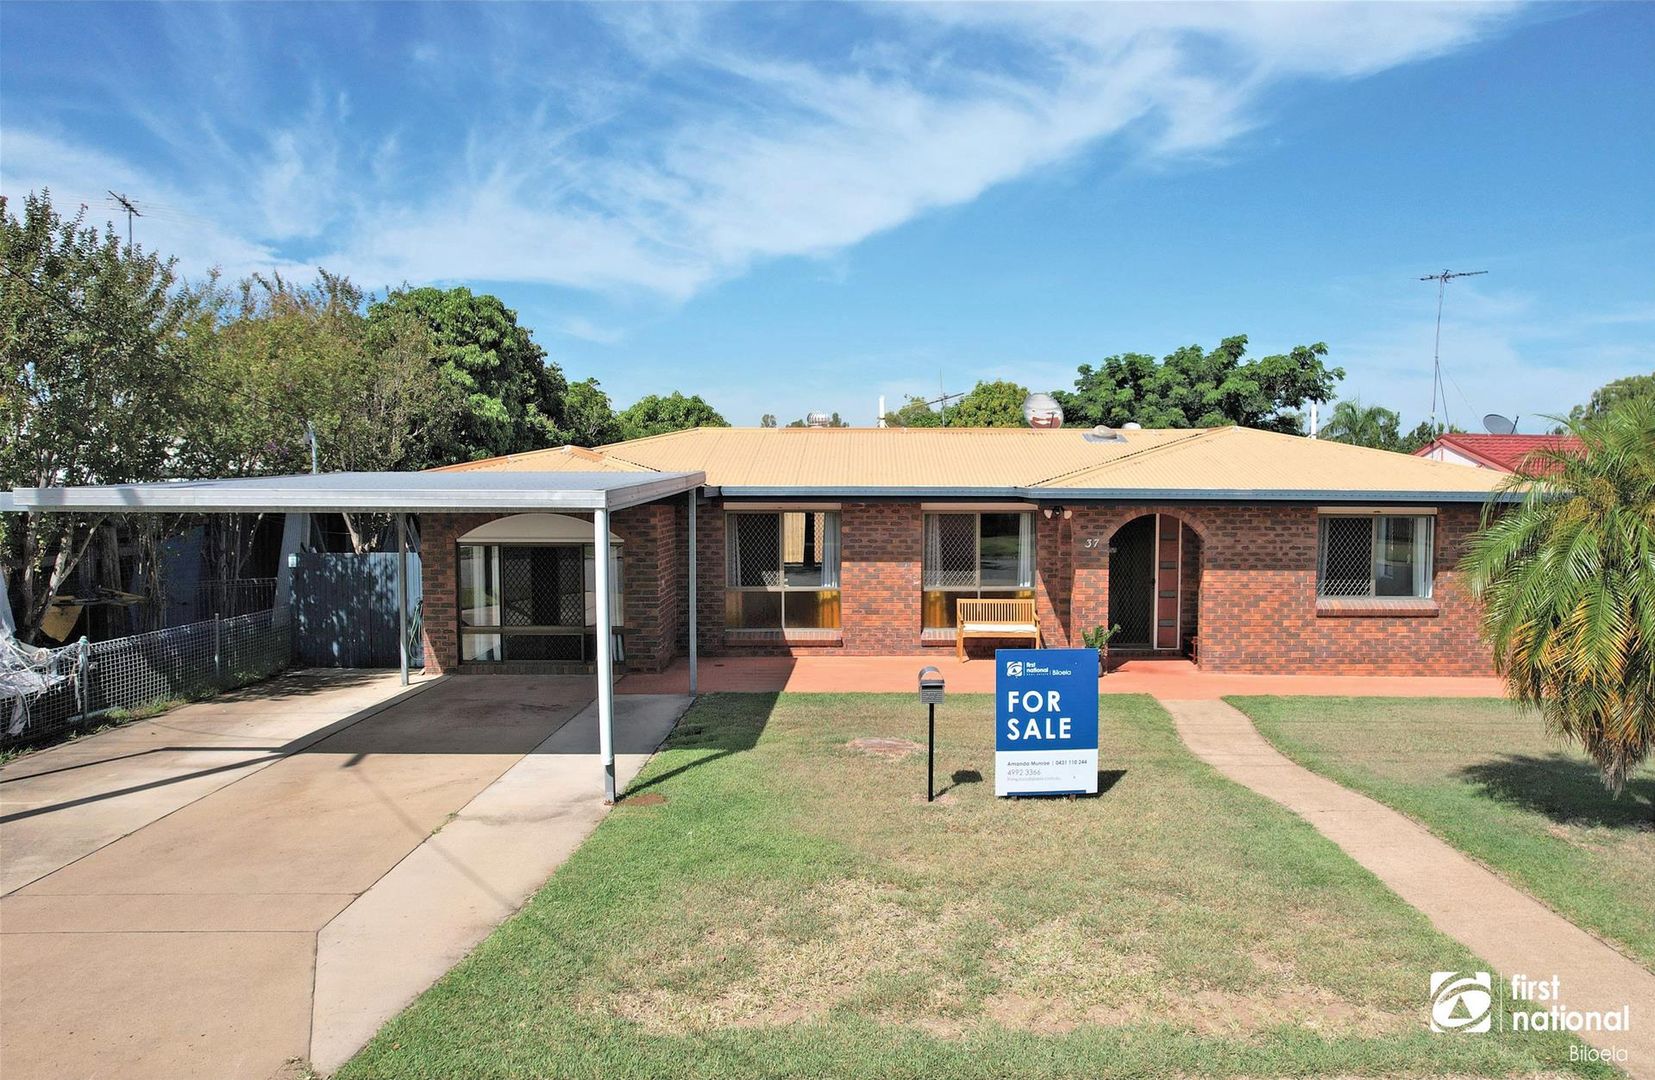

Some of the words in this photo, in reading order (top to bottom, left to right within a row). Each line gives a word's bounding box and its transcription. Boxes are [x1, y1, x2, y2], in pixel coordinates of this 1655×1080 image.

[1085, 538, 1100, 548] 37
[1008, 690, 1061, 713] FOR
[1007, 717, 1072, 741] SALE
[1007, 768, 1024, 776] 4992
